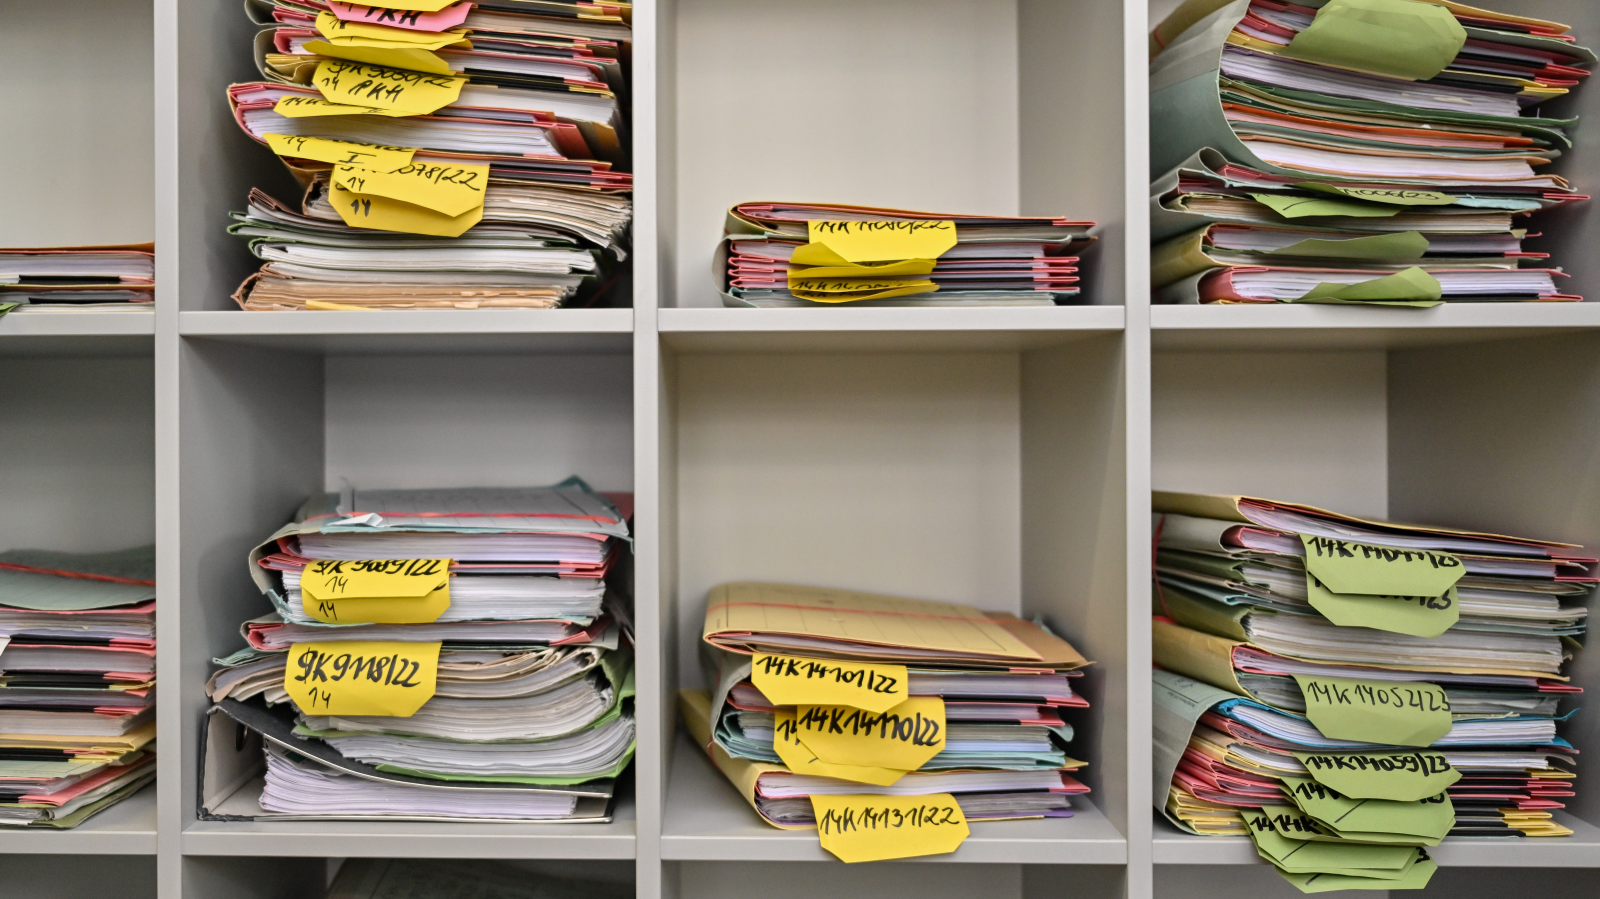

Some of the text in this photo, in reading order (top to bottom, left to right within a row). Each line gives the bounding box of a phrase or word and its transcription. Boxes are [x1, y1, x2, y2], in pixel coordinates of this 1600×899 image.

[322, 76, 404, 103] 14 PKH
[283, 136, 307, 152] 14
[347, 176, 365, 191] 14
[387, 164, 480, 191] 078/22
[351, 198, 371, 217] 14
[324, 576, 348, 593] 14
[319, 601, 337, 620] 14
[308, 687, 331, 709] 14
